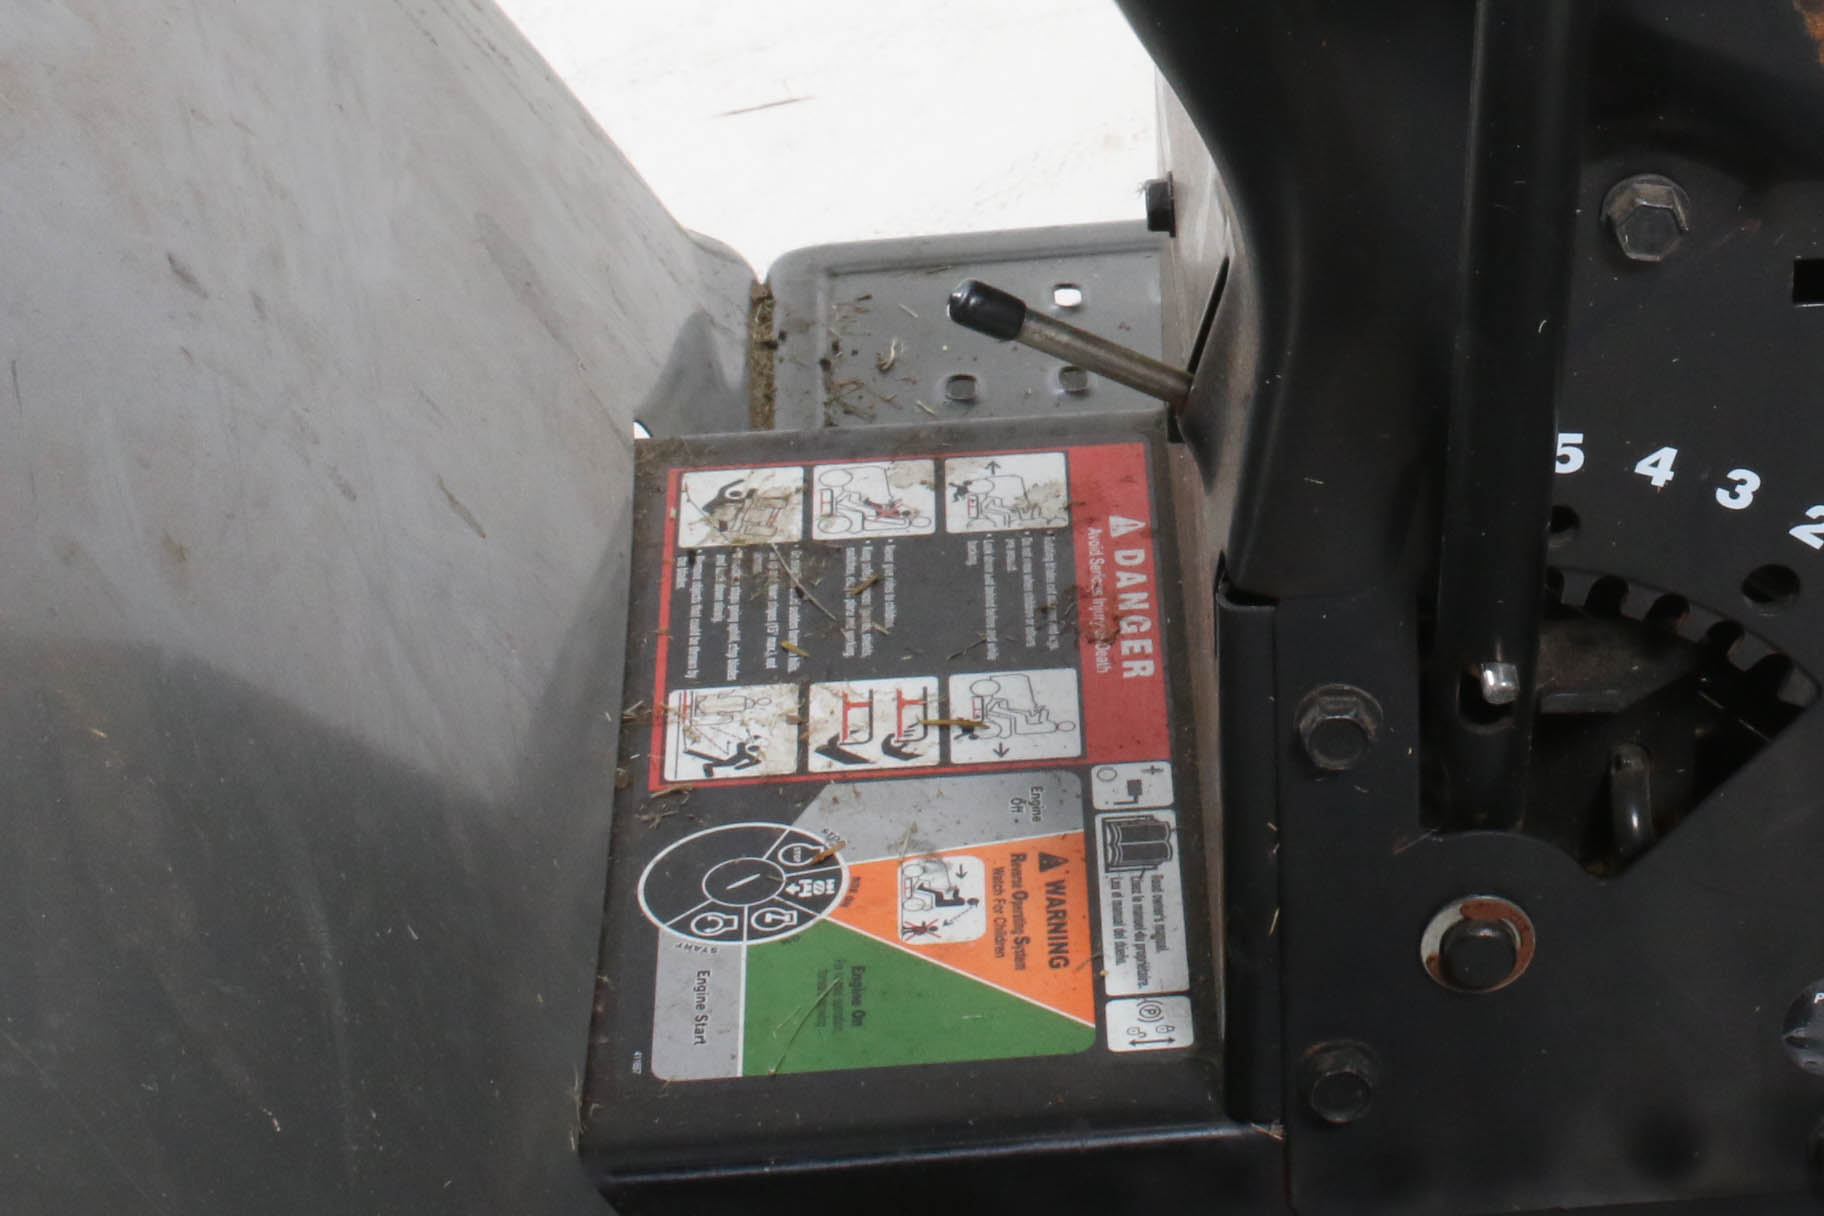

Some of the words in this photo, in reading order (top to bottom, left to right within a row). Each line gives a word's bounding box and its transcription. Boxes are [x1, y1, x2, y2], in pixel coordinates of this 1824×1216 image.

[1555, 433, 1585, 474] 5
[1634, 446, 1679, 488] 4
[1715, 468, 1761, 510] 3
[1088, 528, 1104, 555] Avoid
[1089, 558, 1106, 595] Serious
[1089, 599, 1107, 626] Injury
[1114, 548, 1155, 679] DANGER
[1095, 643, 1111, 673] Death
[1010, 797, 1026, 813] Off
[1029, 786, 1044, 822] Engine
[992, 867, 1006, 895] Watch
[993, 898, 1006, 913] For
[994, 917, 1008, 958] Children
[1045, 880, 1070, 969] WARNING
[693, 970, 711, 1010] Engine
[849, 965, 867, 1005] Engine
[694, 1015, 709, 1045] Start
[851, 1010, 867, 1026] On
